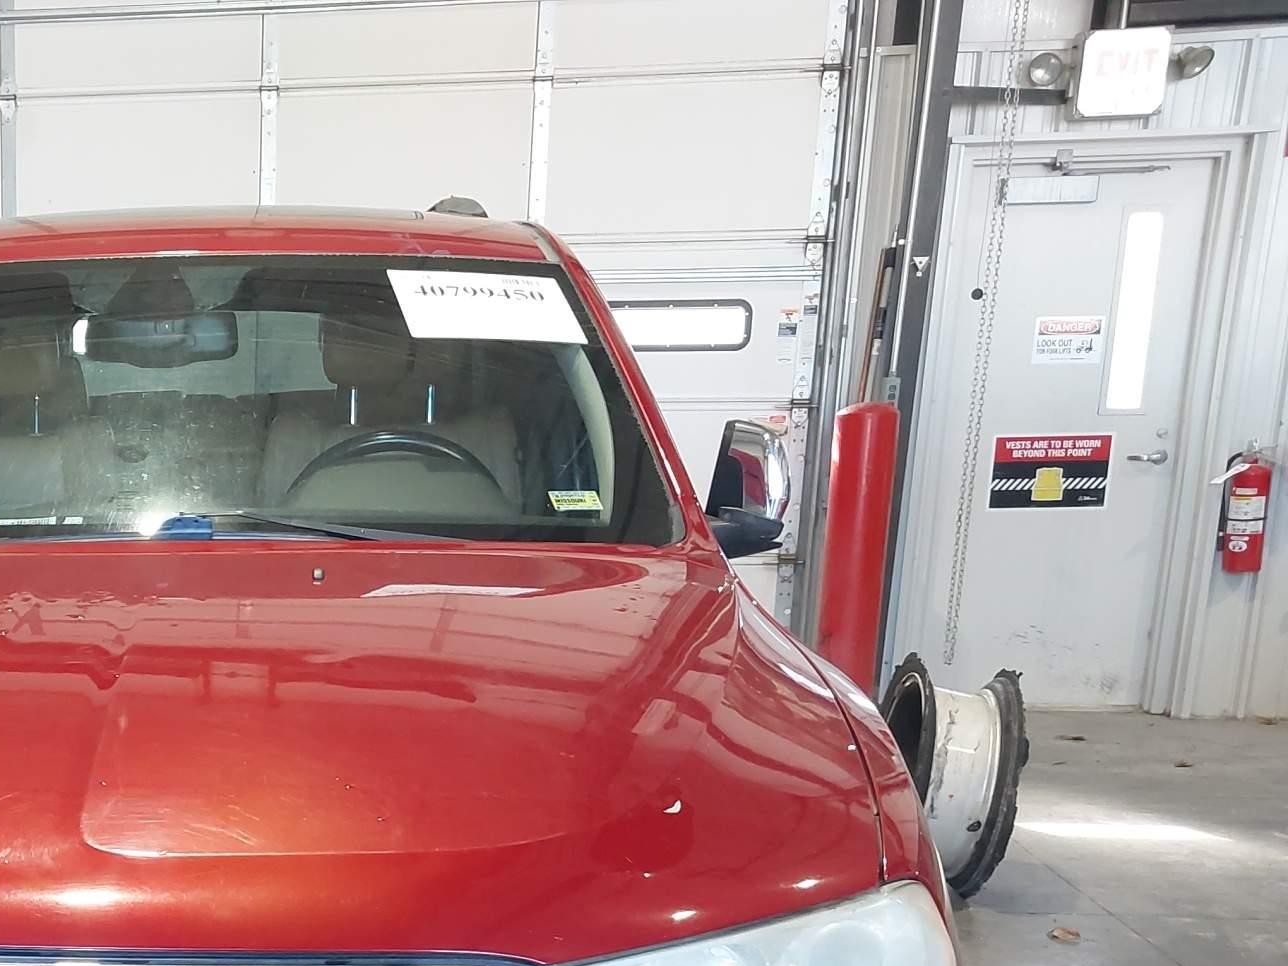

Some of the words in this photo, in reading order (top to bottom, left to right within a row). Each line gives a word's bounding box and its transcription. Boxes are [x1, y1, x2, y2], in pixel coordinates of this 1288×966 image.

[1096, 48, 1159, 75] EXIT
[414, 285, 545, 301] 40799450
[1047, 322, 1092, 332] DANGER
[1036, 338, 1057, 347] LOOK
[1058, 338, 1073, 347] OUT
[1005, 440, 1032, 449] VESTS
[1032, 440, 1049, 449] ARE
[1050, 440, 1061, 448] TO
[1063, 440, 1074, 448] BE
[1075, 440, 1101, 448] WORN
[1012, 449, 1046, 458] BEYOND
[1047, 448, 1066, 457] THIS
[1067, 448, 1093, 457] POINT
